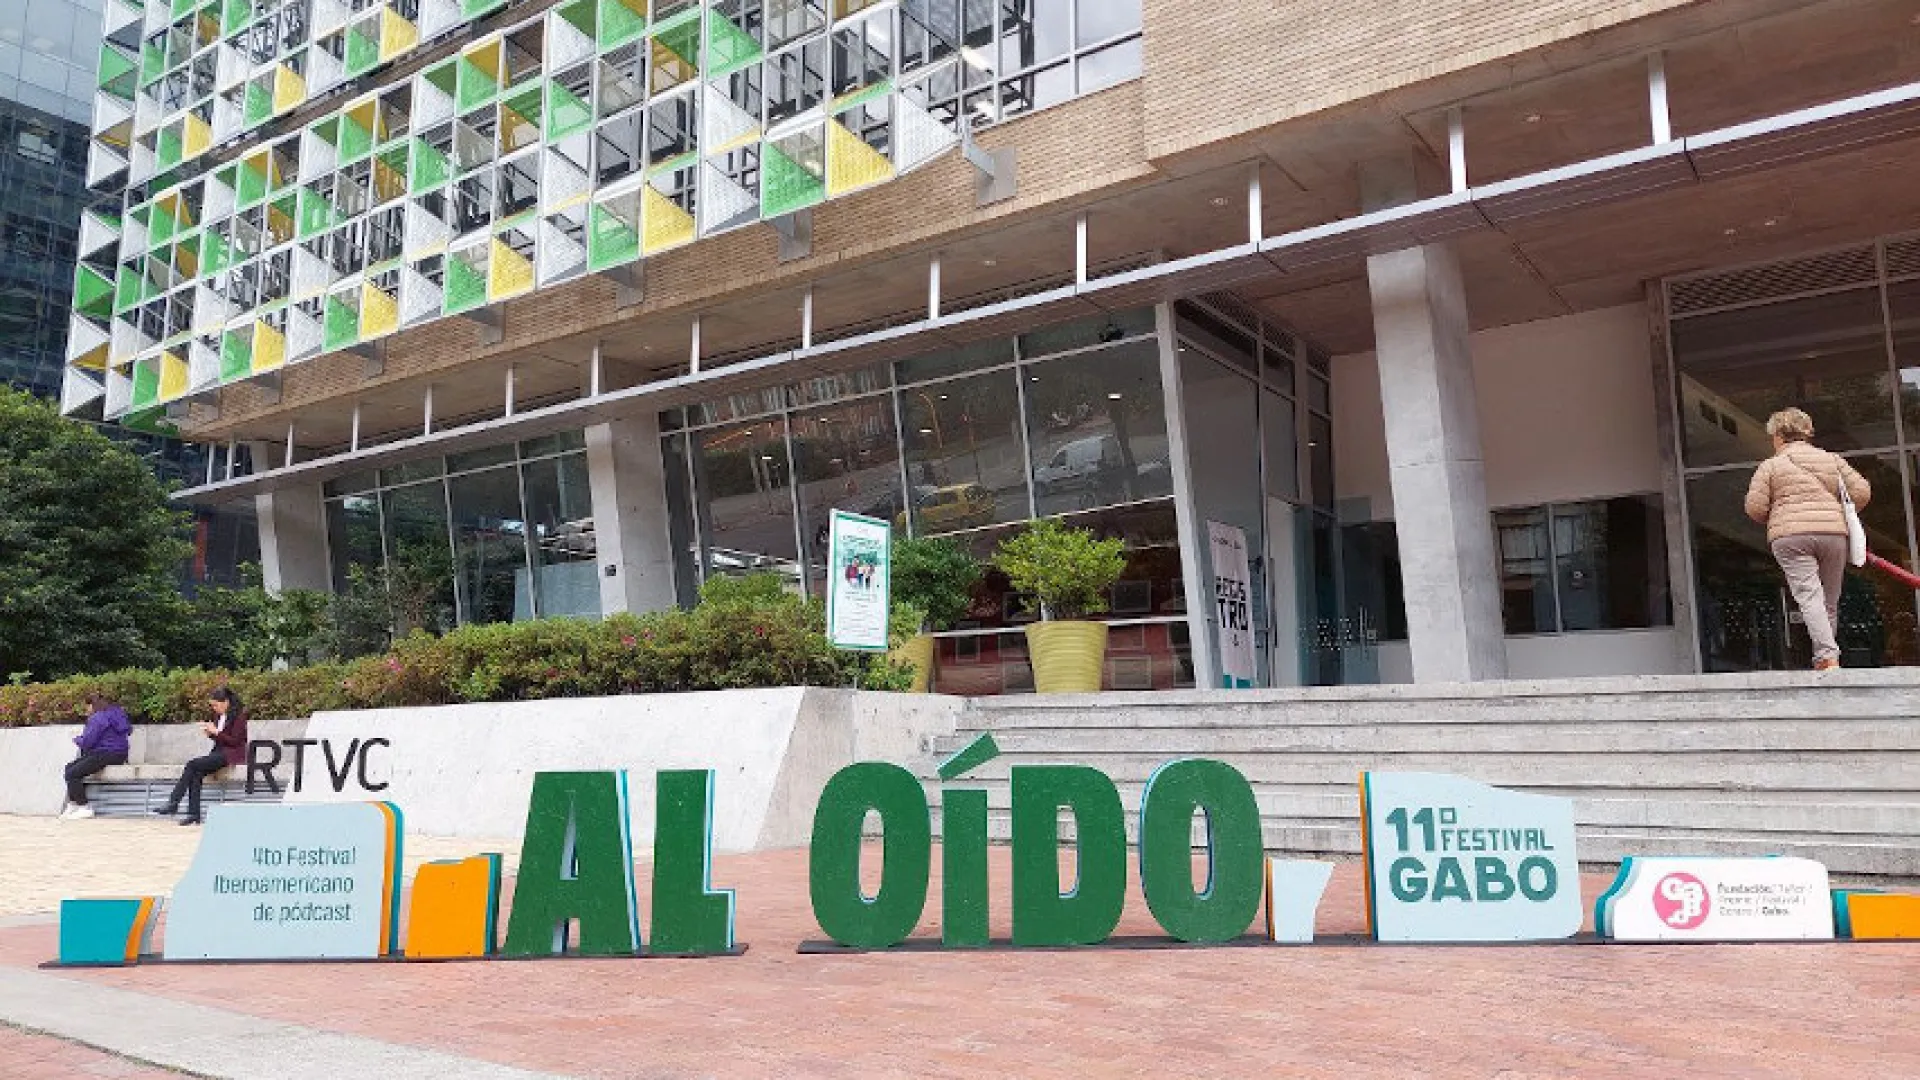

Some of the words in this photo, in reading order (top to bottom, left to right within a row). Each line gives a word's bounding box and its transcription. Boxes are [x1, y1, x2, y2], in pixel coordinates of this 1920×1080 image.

[245, 738, 390, 794] RTVC
[1440, 828, 1554, 851] FESTIVAL
[253, 847, 282, 865] 4to
[287, 846, 356, 865] Festival
[505, 769, 735, 955] AL
[214, 875, 354, 893] Iberoamericano
[1389, 855, 1558, 902] GABO
[253, 902, 273, 921] de
[279, 902, 352, 925] pódcast
